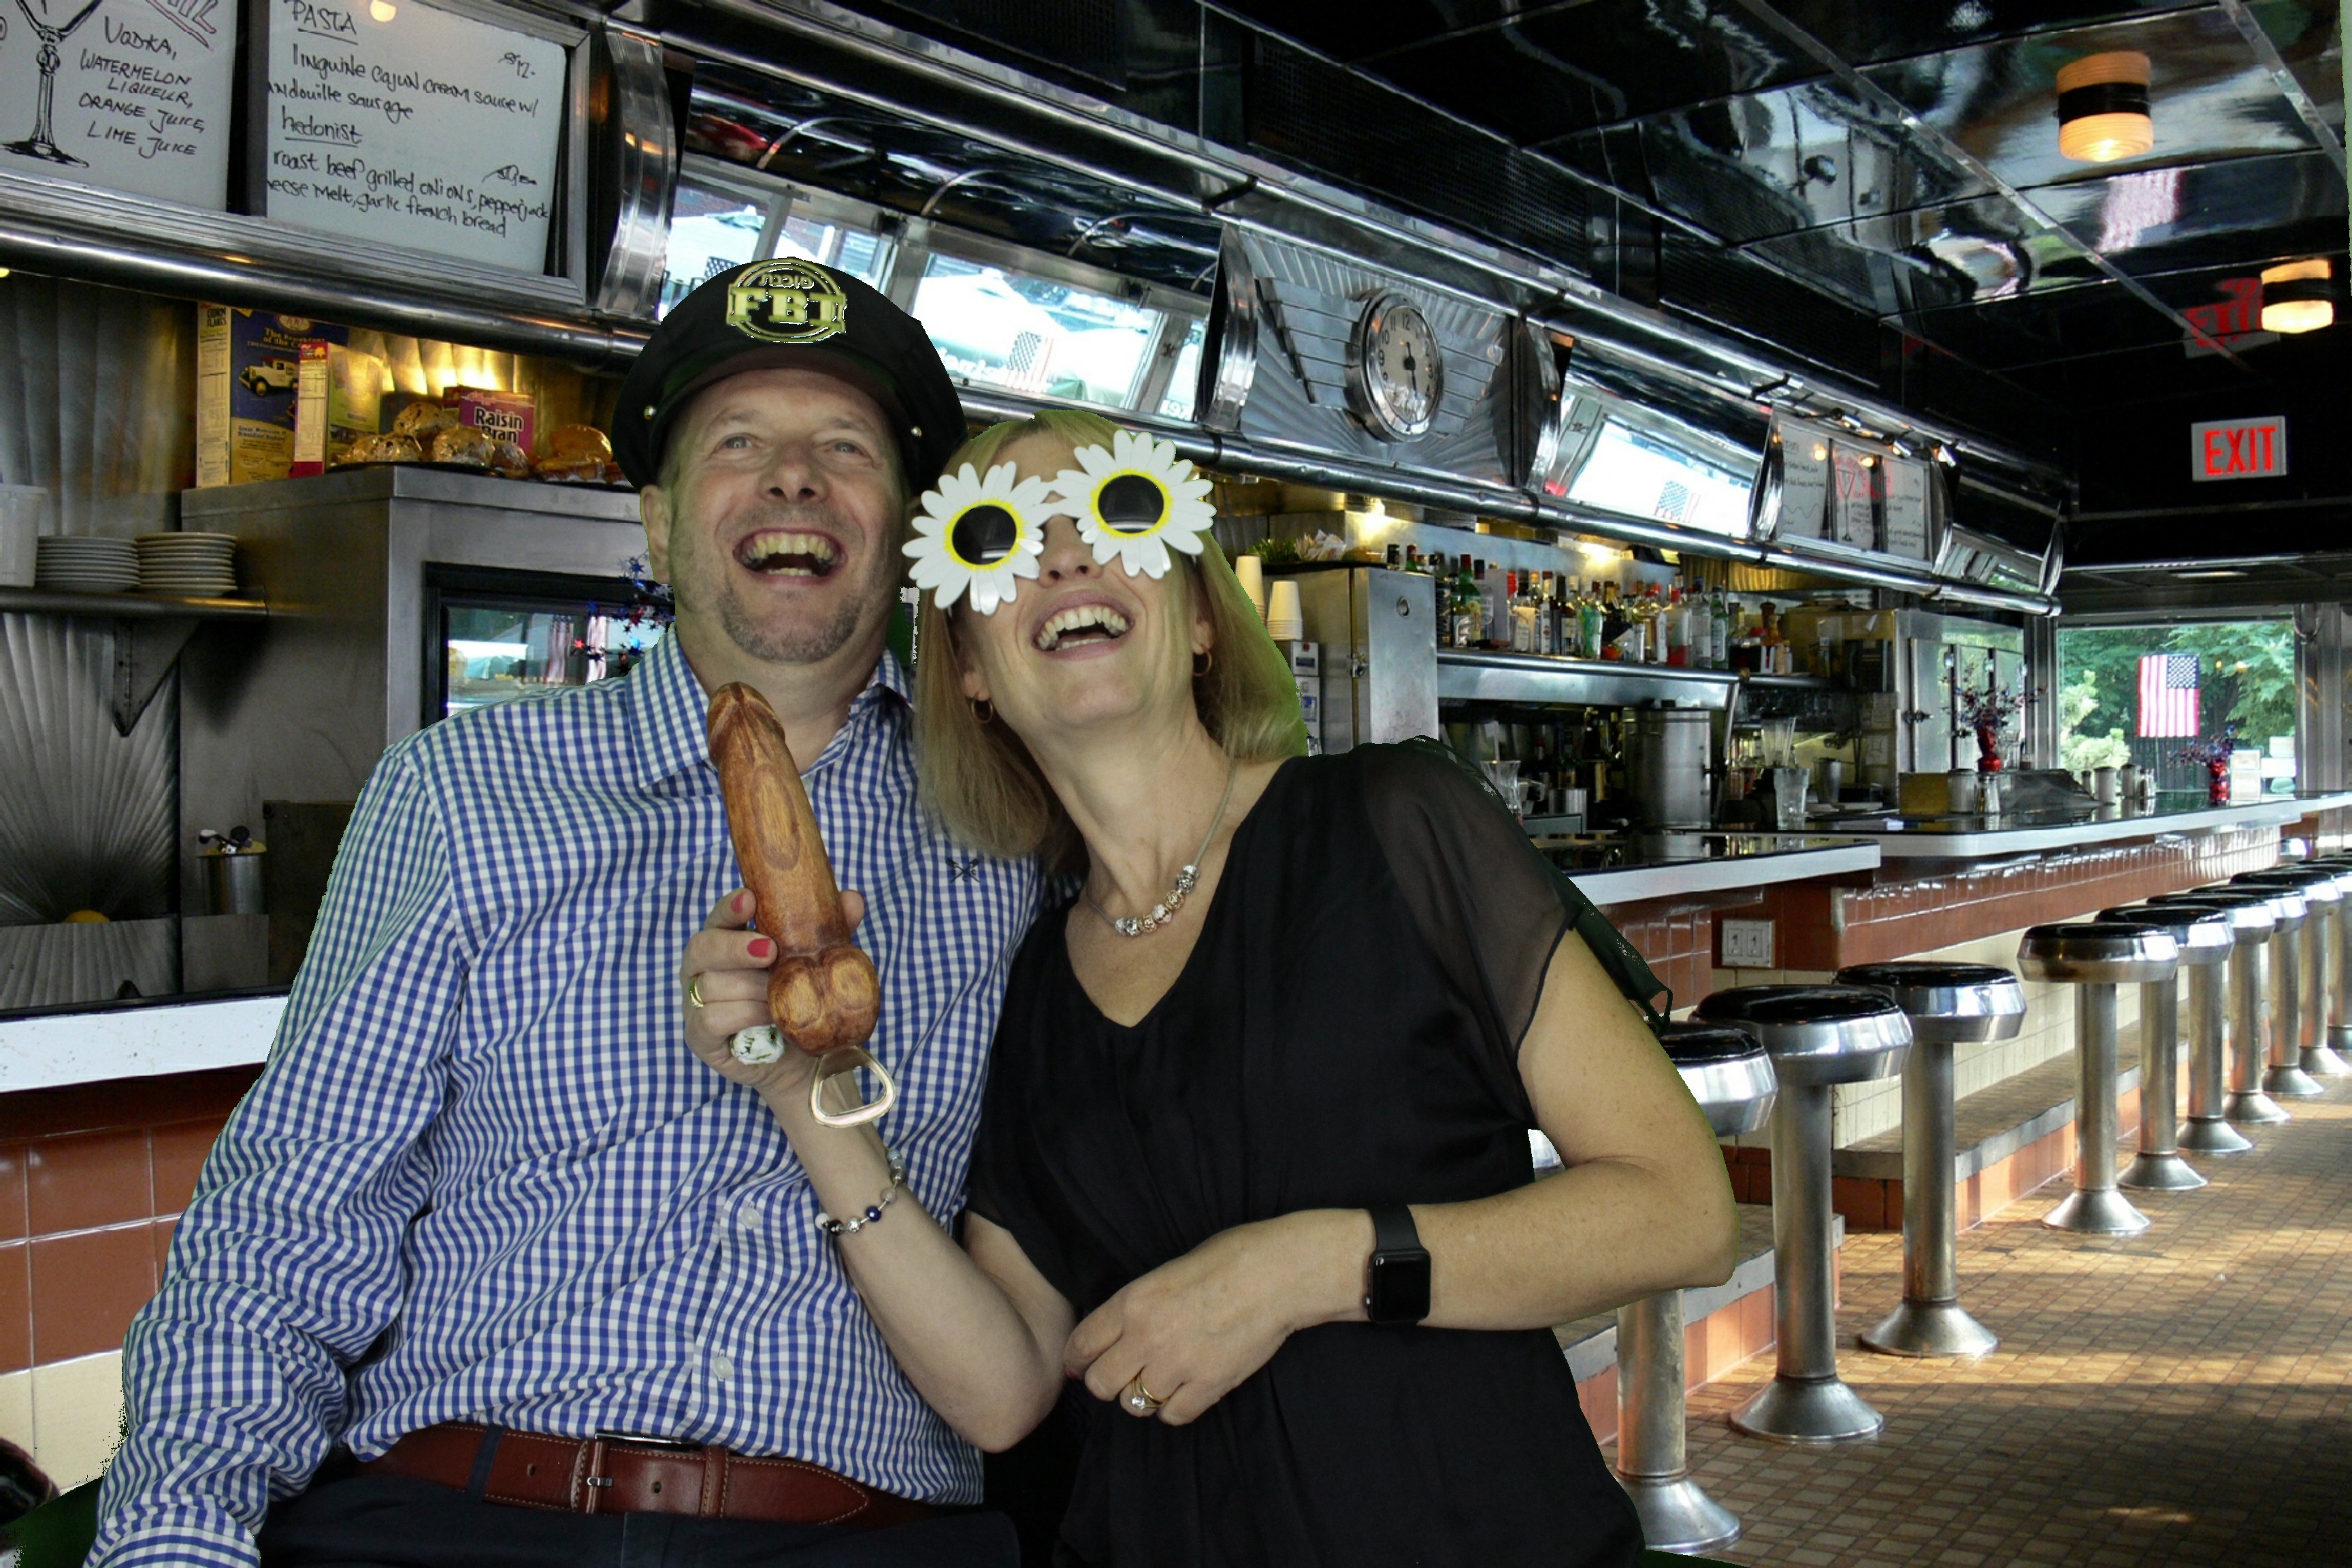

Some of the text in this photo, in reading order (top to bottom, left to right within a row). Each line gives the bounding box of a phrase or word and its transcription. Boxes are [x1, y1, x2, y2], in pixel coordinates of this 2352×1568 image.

[283, 0, 357, 35] PASTA
[80, 48, 193, 86] WATERMELON
[78, 92, 146, 117] ORANGE
[108, 77, 194, 108] LIQUEUR,
[86, 120, 197, 159] LIME JUICE
[281, 105, 364, 144] hedonist
[273, 150, 320, 171] roast
[327, 154, 365, 180] beef
[365, 169, 414, 193] grilled
[462, 210, 506, 238] bread
[728, 287, 845, 332] FBI
[1390, 314, 1396, 331] 11
[1402, 312, 1411, 331] 12
[1382, 329, 1390, 345] 10
[1378, 349, 1385, 366] 9
[474, 406, 524, 431] Raisin
[2204, 425, 2276, 476] EXIT
